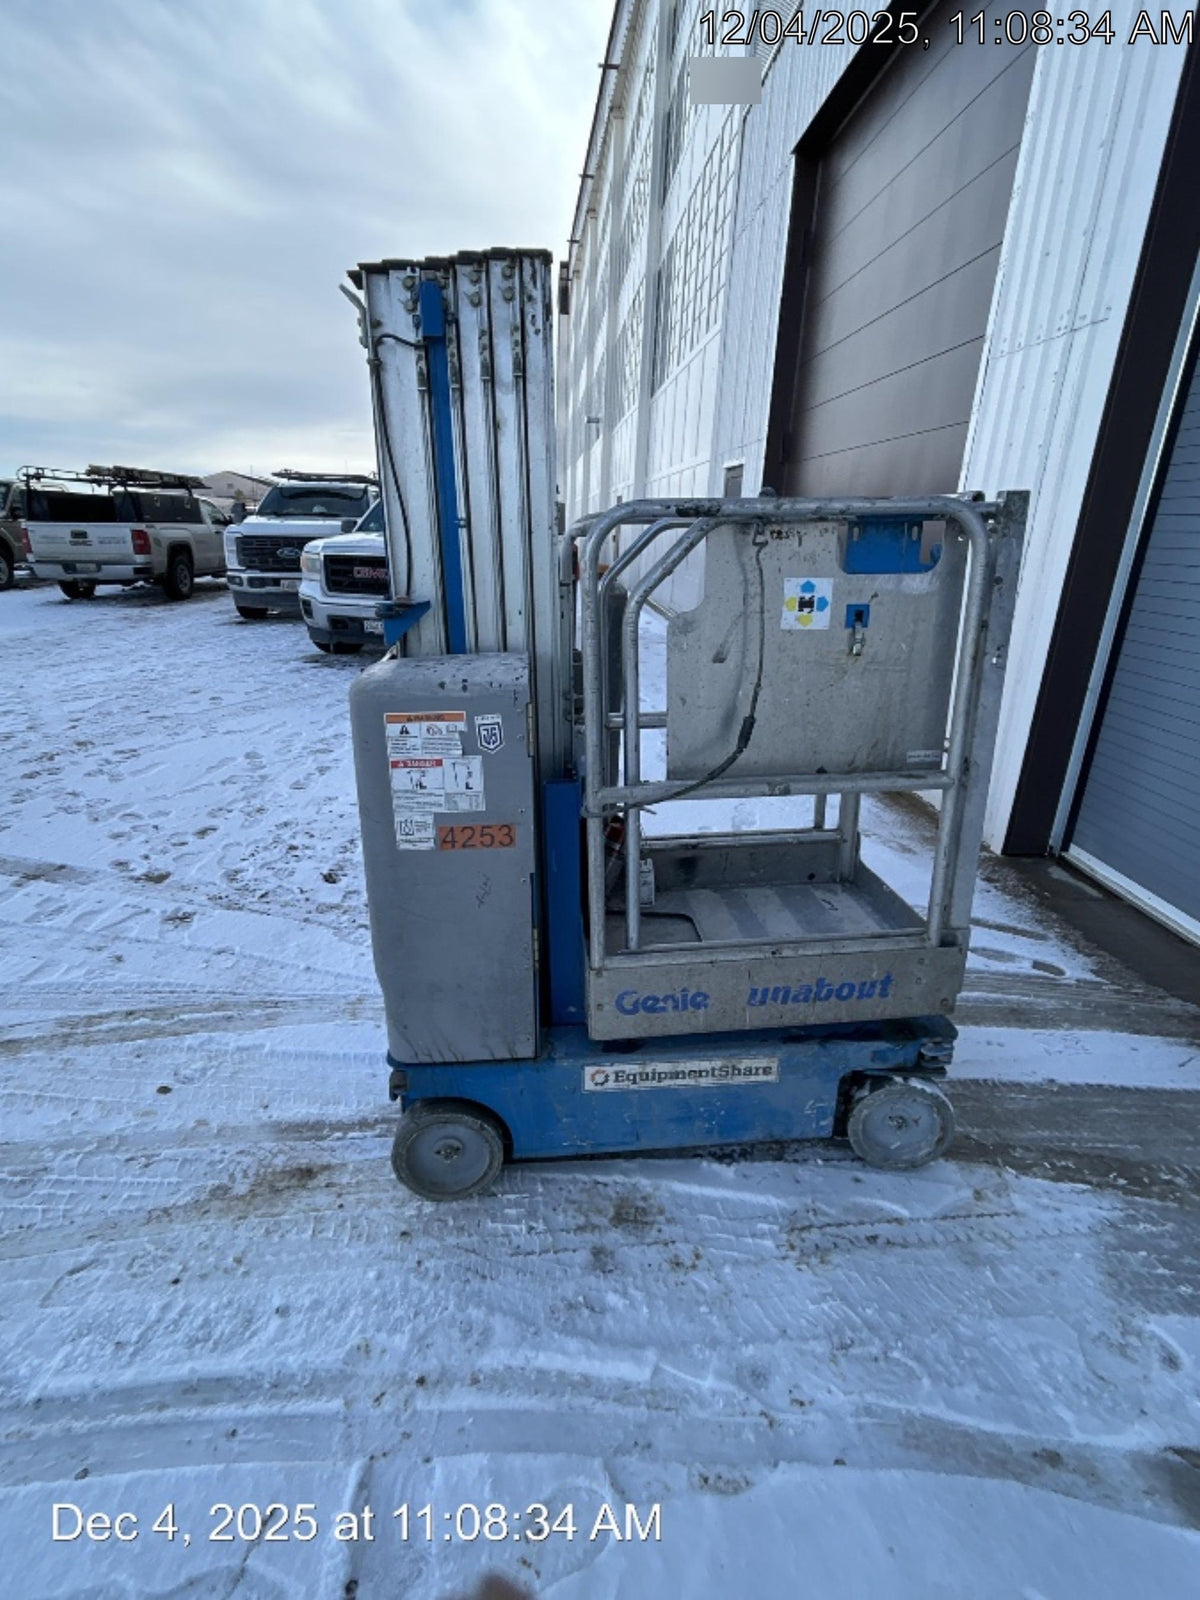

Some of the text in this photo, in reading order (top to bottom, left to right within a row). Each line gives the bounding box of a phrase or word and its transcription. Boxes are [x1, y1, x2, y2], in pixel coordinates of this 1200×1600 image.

[441, 825, 514, 848] 4253
[615, 987, 710, 1016] Genie
[612, 1064, 773, 1085] EquipmentShare
